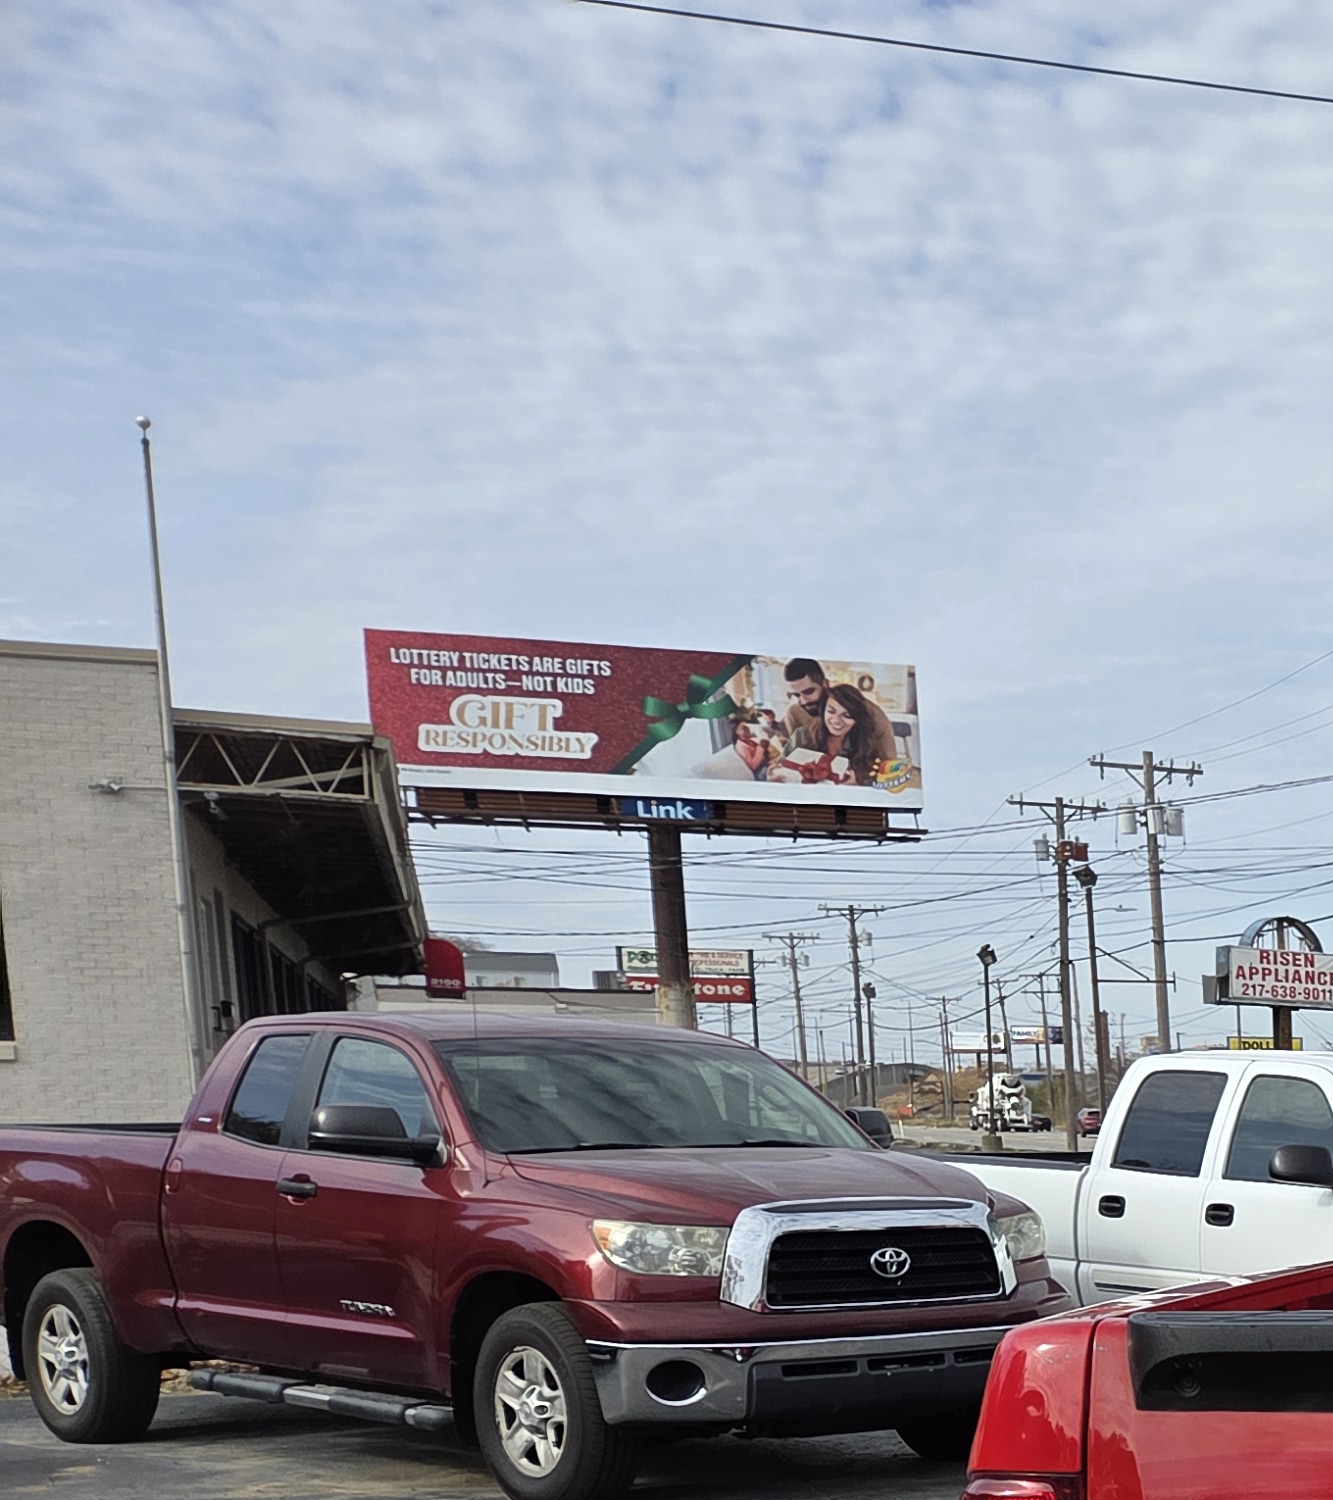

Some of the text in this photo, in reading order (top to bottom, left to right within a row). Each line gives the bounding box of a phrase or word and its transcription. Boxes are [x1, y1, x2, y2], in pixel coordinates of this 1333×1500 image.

[390, 647, 612, 677] LOTTERY TICKETS ARE GIFTS
[410, 668, 443, 686] FOR
[556, 676, 596, 695] KIDS
[456, 699, 558, 732] GIFT
[424, 729, 593, 754] RESPONSIBLY
[636, 799, 697, 820] Link
[1259, 949, 1315, 968] RISEN
[1241, 983, 1333, 1001] 217-638-9011
